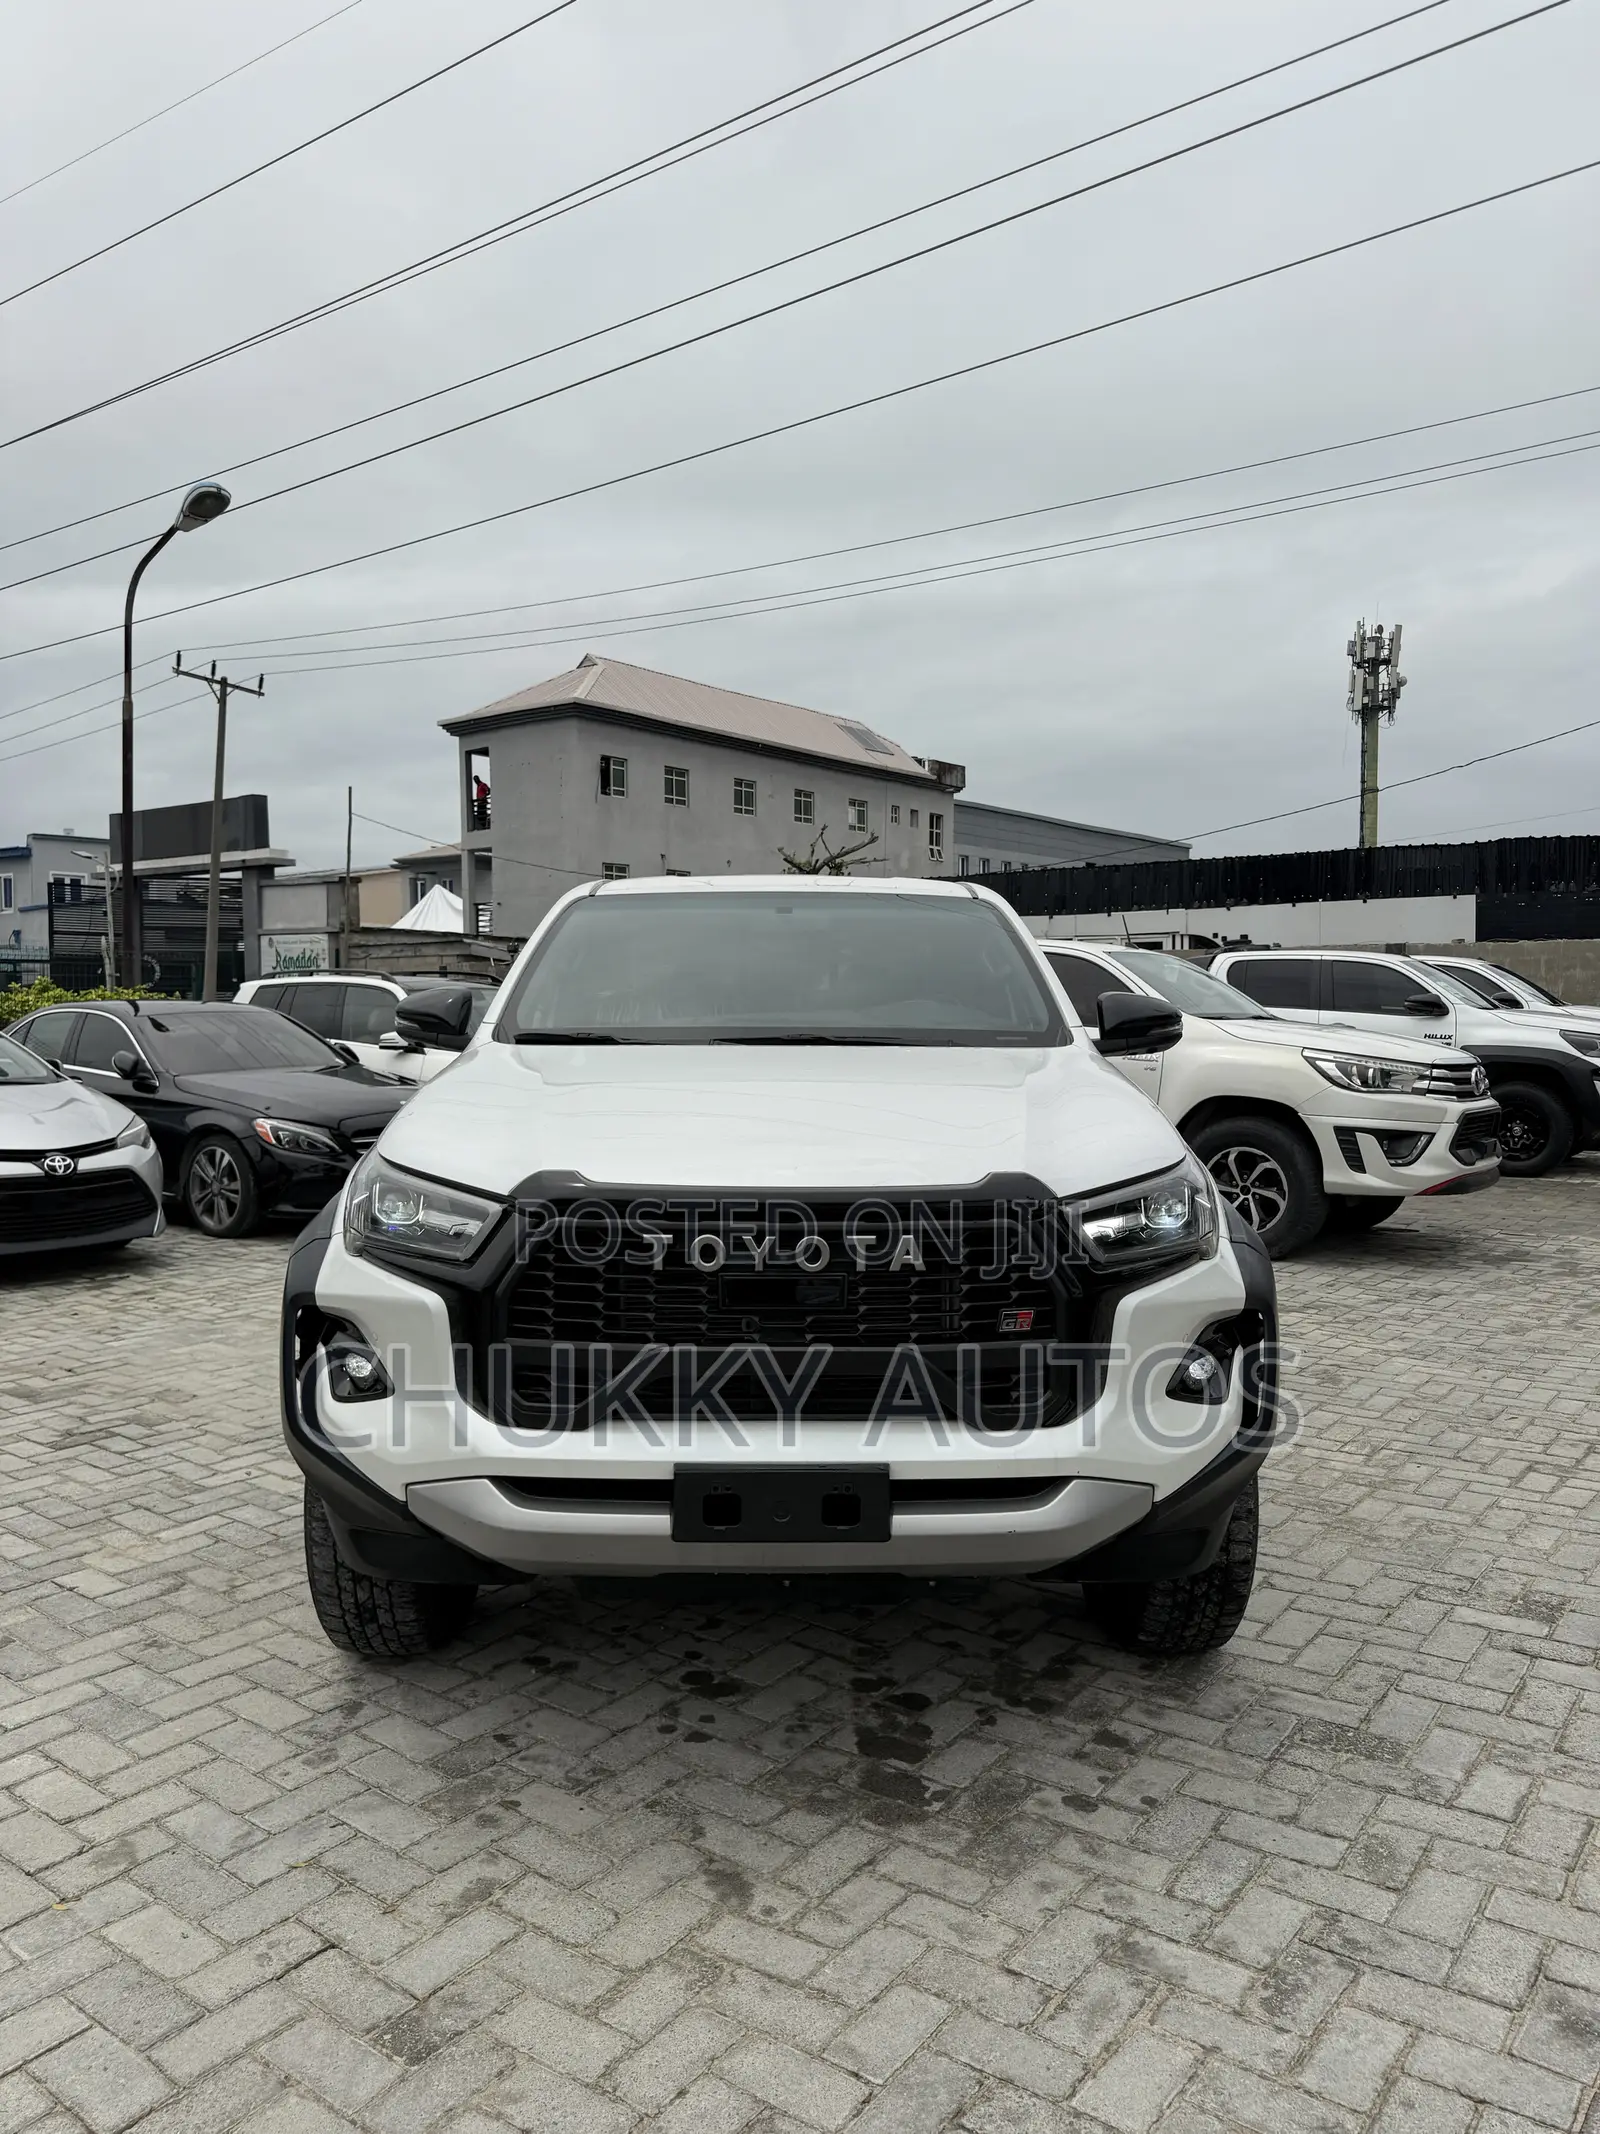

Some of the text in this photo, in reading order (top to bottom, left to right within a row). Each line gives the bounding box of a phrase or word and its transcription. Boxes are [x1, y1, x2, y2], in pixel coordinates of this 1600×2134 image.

[271, 945, 321, 971] Ramadan
[642, 1233, 926, 1272] TOYOTA
[1002, 1318, 1030, 1329] GR
